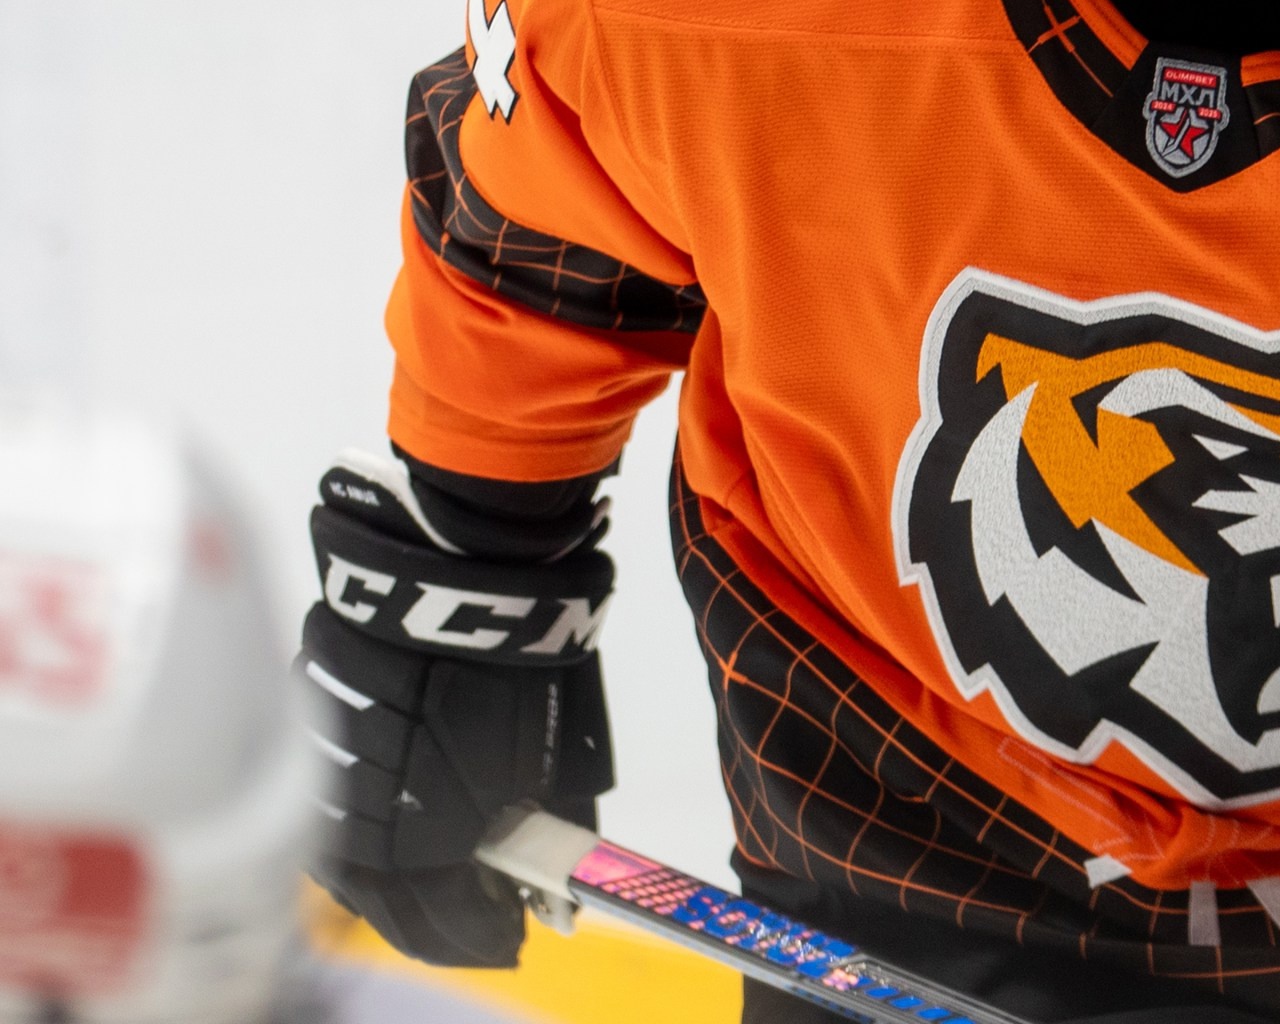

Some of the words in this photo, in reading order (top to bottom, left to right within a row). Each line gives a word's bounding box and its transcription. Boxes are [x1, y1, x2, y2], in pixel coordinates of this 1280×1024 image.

[1165, 69, 1215, 86] OLIMPBET
[1160, 80, 1216, 109] МХЛ
[325, 553, 616, 655] CCM
